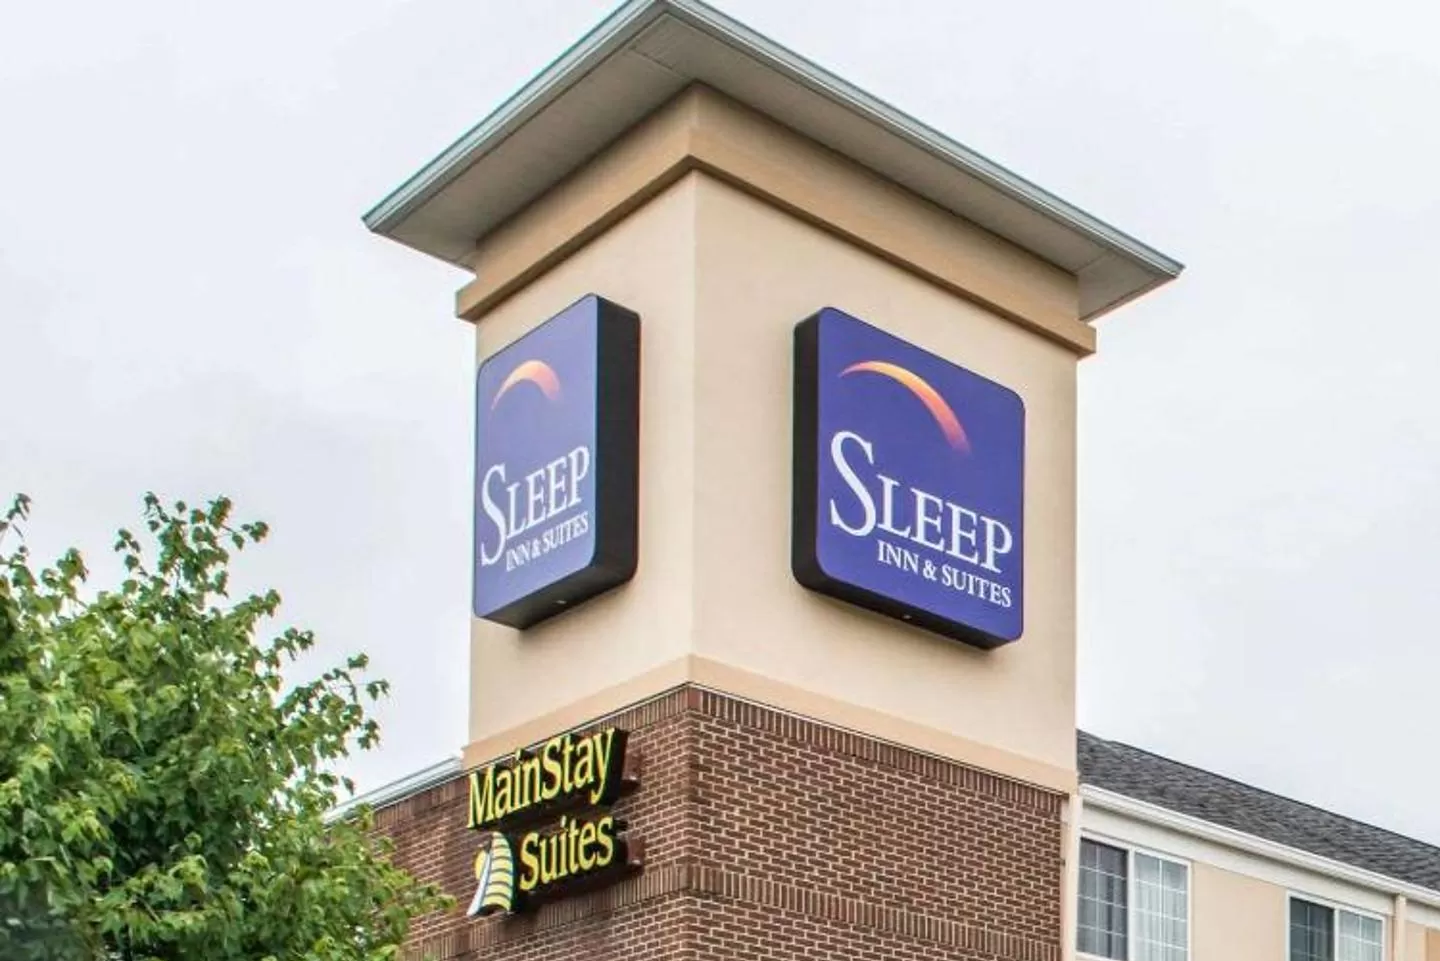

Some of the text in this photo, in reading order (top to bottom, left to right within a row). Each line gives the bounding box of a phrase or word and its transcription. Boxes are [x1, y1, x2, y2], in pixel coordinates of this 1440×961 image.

[481, 445, 590, 567] SLEEP
[506, 511, 589, 572] INN & SUITES
[830, 430, 1013, 574] SLEEP
[877, 539, 1012, 608] INN & SUITES
[467, 727, 616, 829] MainStay
[519, 815, 614, 891] Suites
